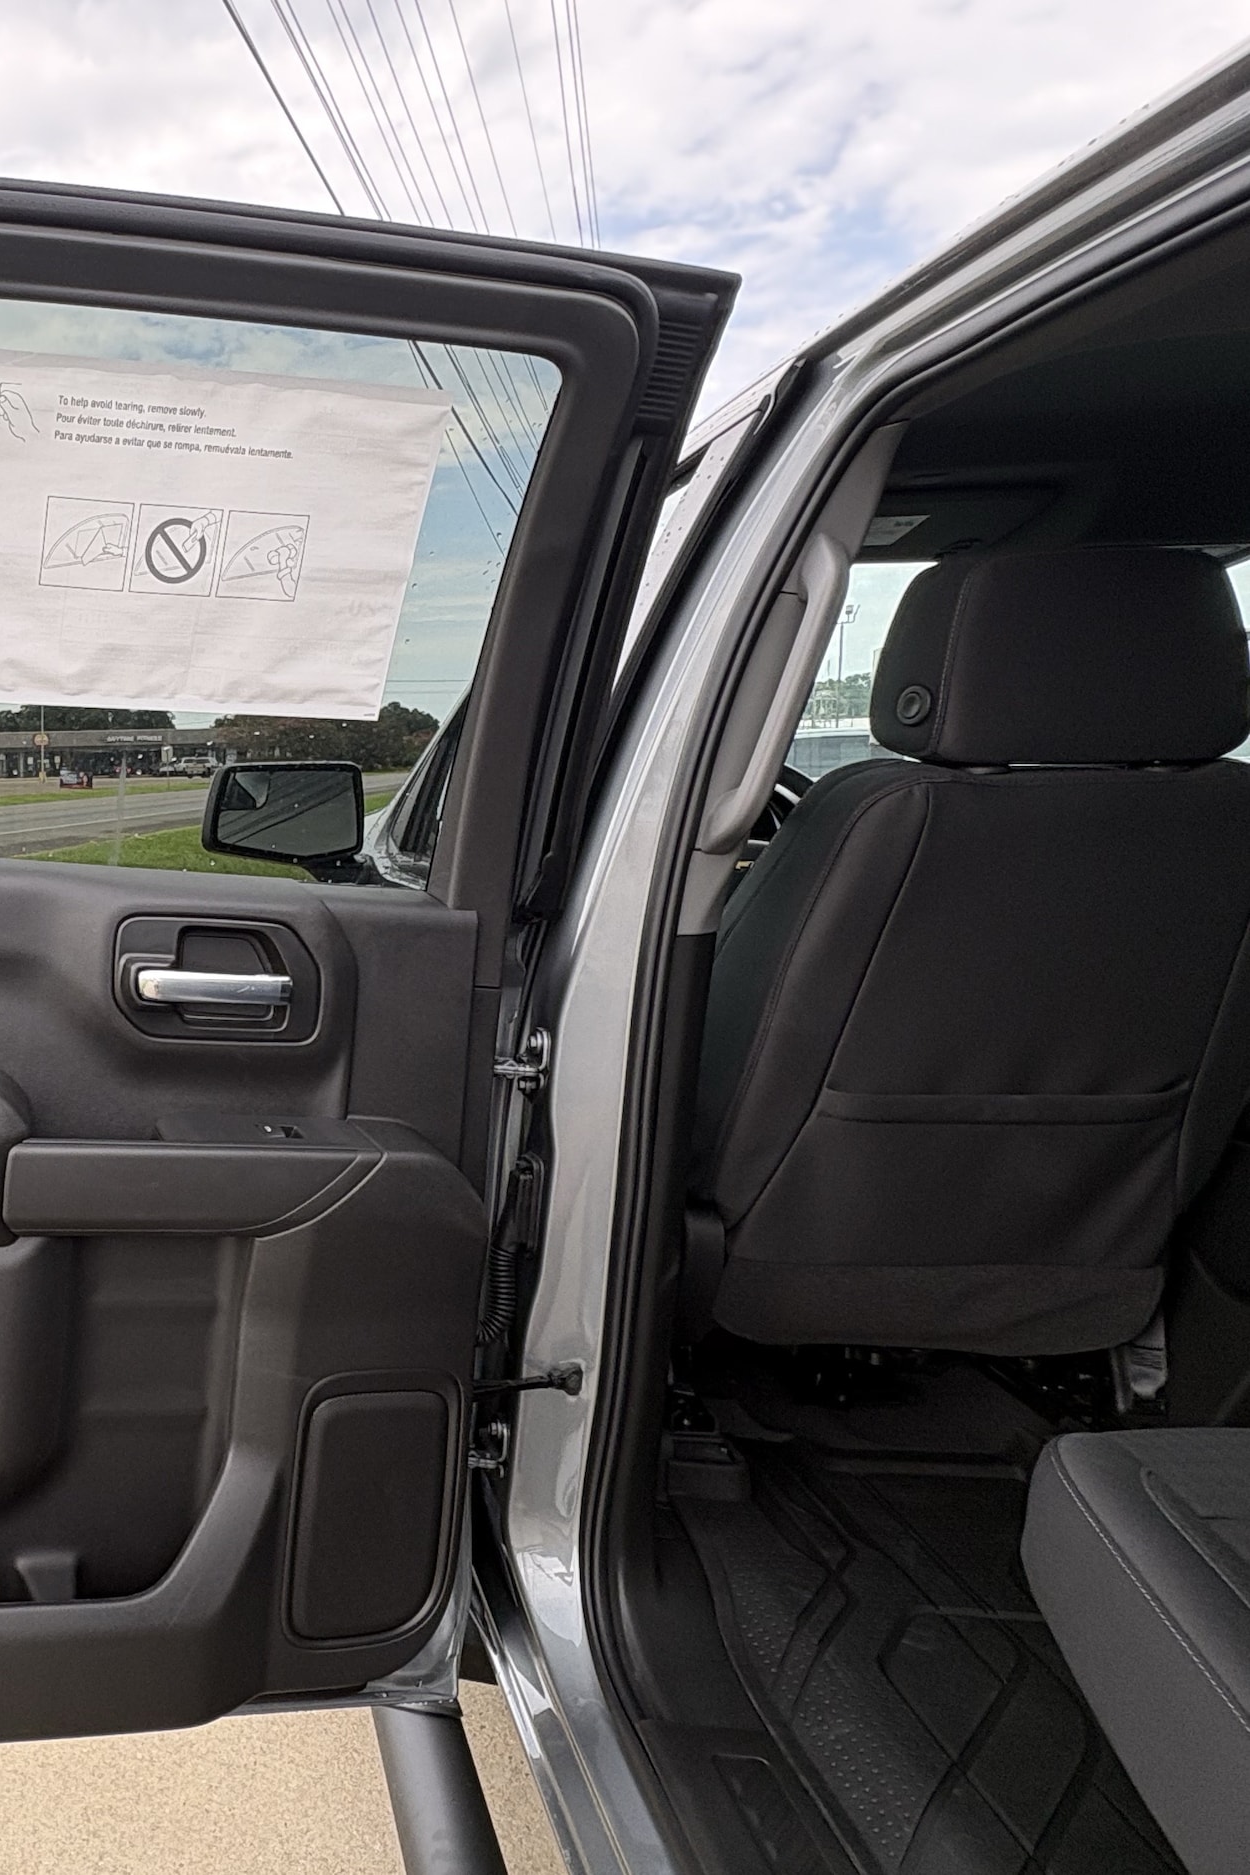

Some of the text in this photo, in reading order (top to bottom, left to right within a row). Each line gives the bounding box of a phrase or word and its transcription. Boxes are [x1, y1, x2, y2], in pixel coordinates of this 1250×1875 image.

[58, 395, 207, 419] To help avoid tearing, remove slowly.
[56, 412, 237, 437] Pour éviter toute déchirure, retirer lentement.
[54, 430, 294, 459] Para ayudarse a evitar que se rompa, remuévala lentamente.
